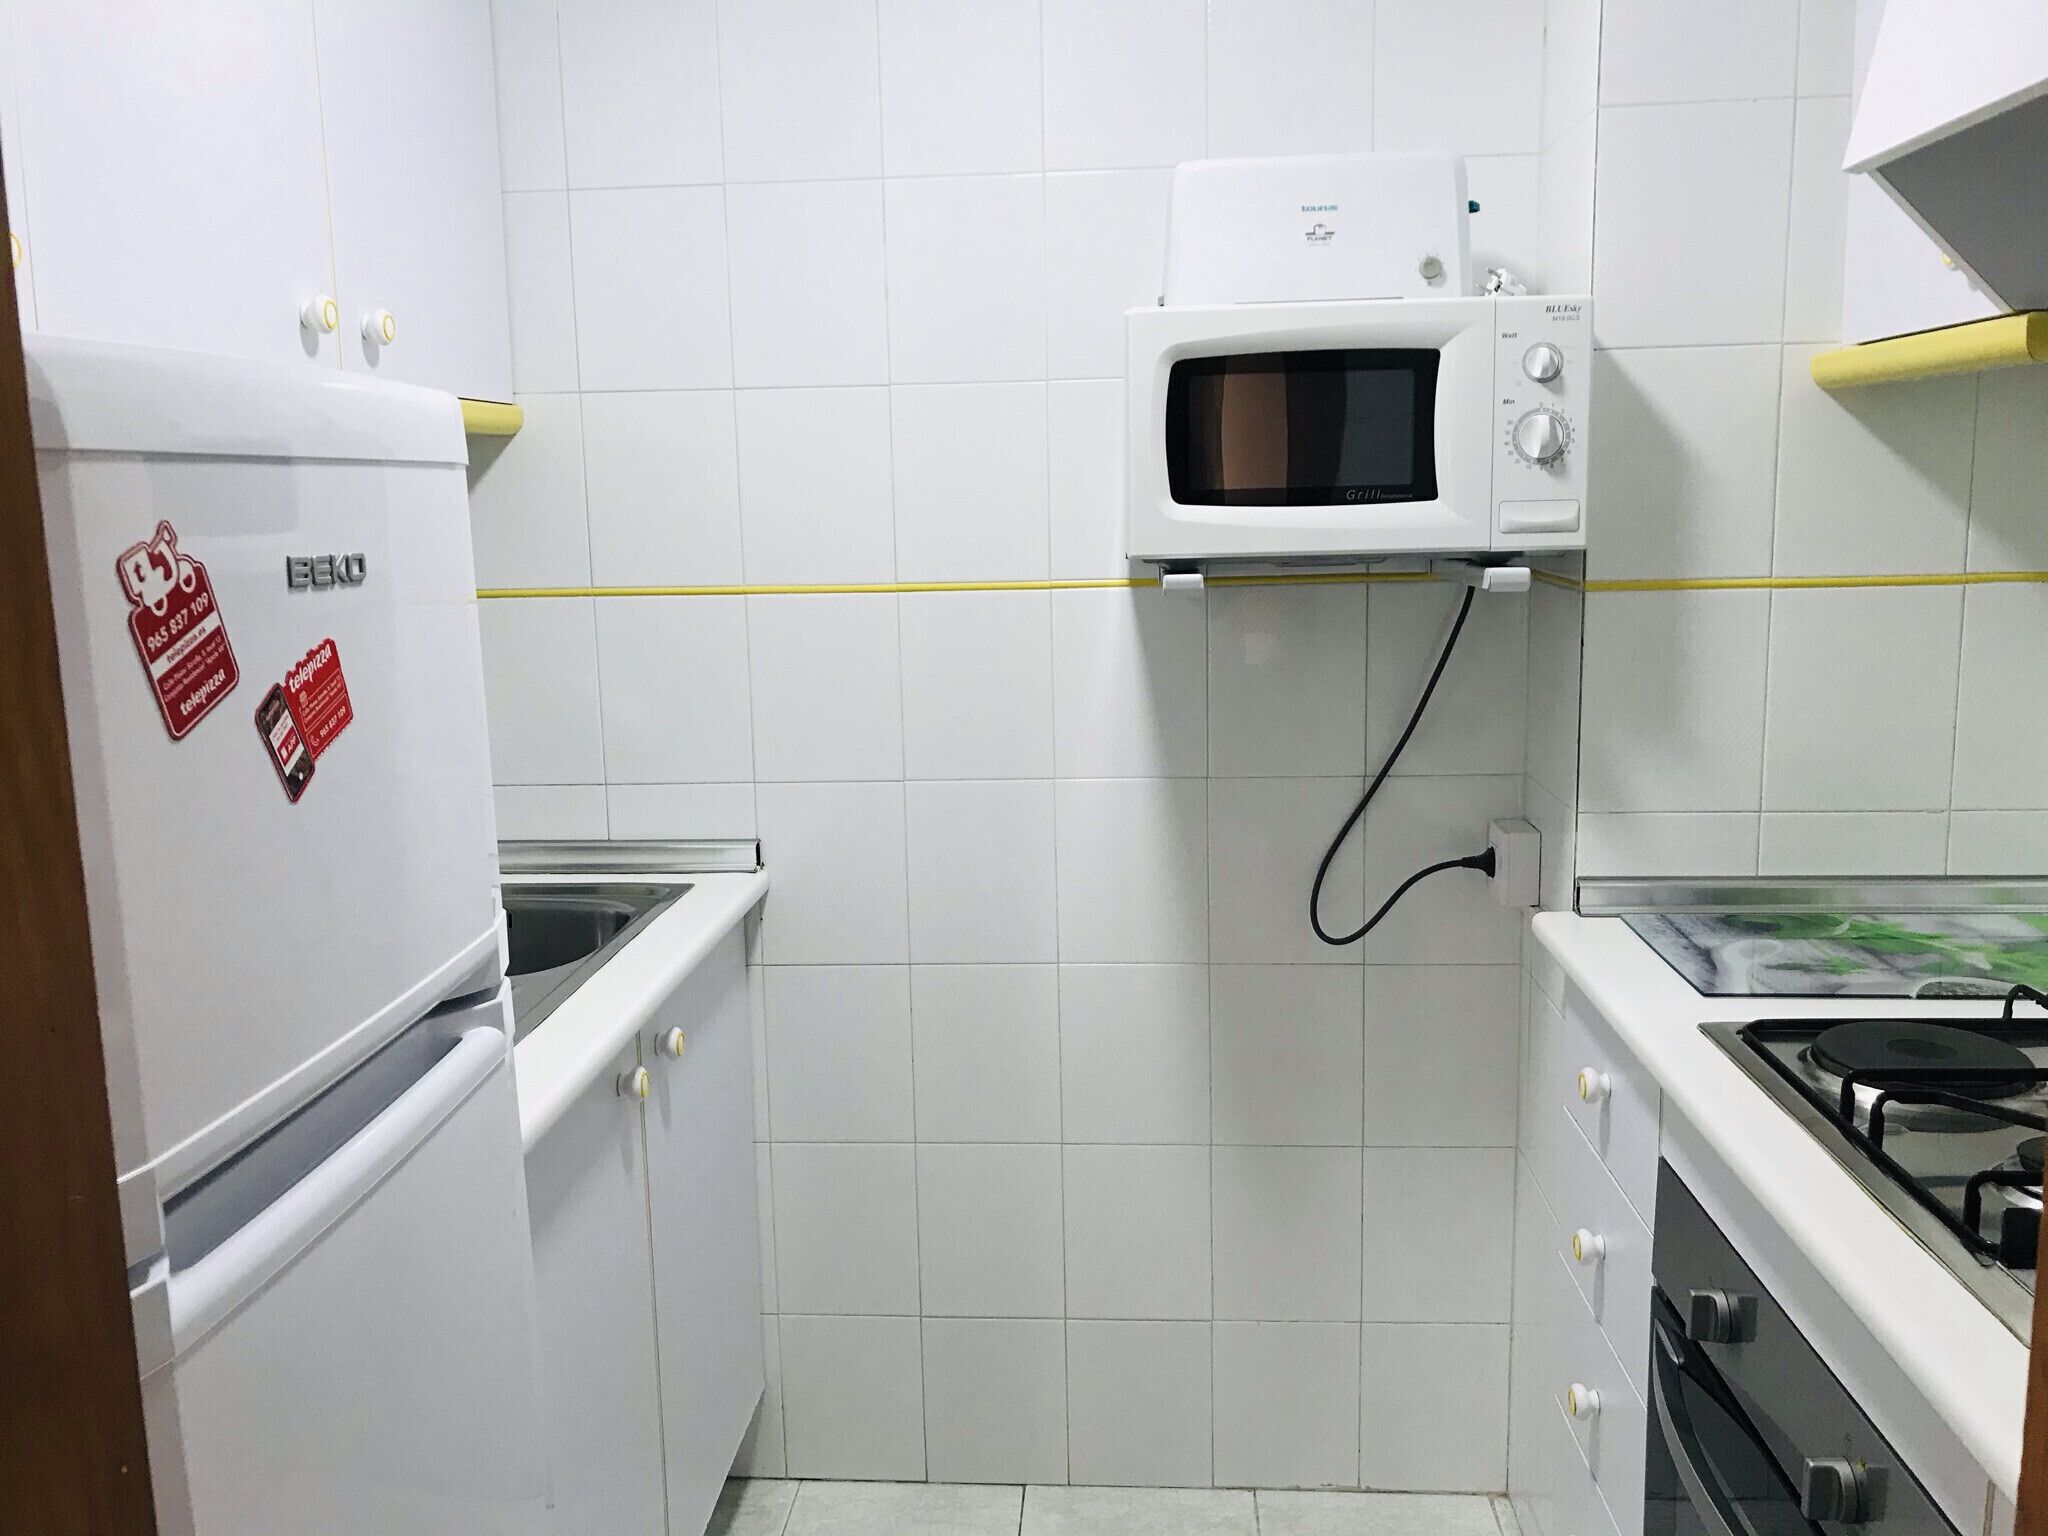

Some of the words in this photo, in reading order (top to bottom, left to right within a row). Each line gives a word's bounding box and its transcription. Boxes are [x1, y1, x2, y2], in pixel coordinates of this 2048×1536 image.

[1346, 489, 1381, 500] Grill
[286, 551, 368, 590] BEKO
[147, 626, 169, 652] 965
[169, 608, 188, 634] 837
[191, 593, 209, 616] 109
[180, 669, 226, 716] telepizza
[289, 644, 331, 694] telepizza
